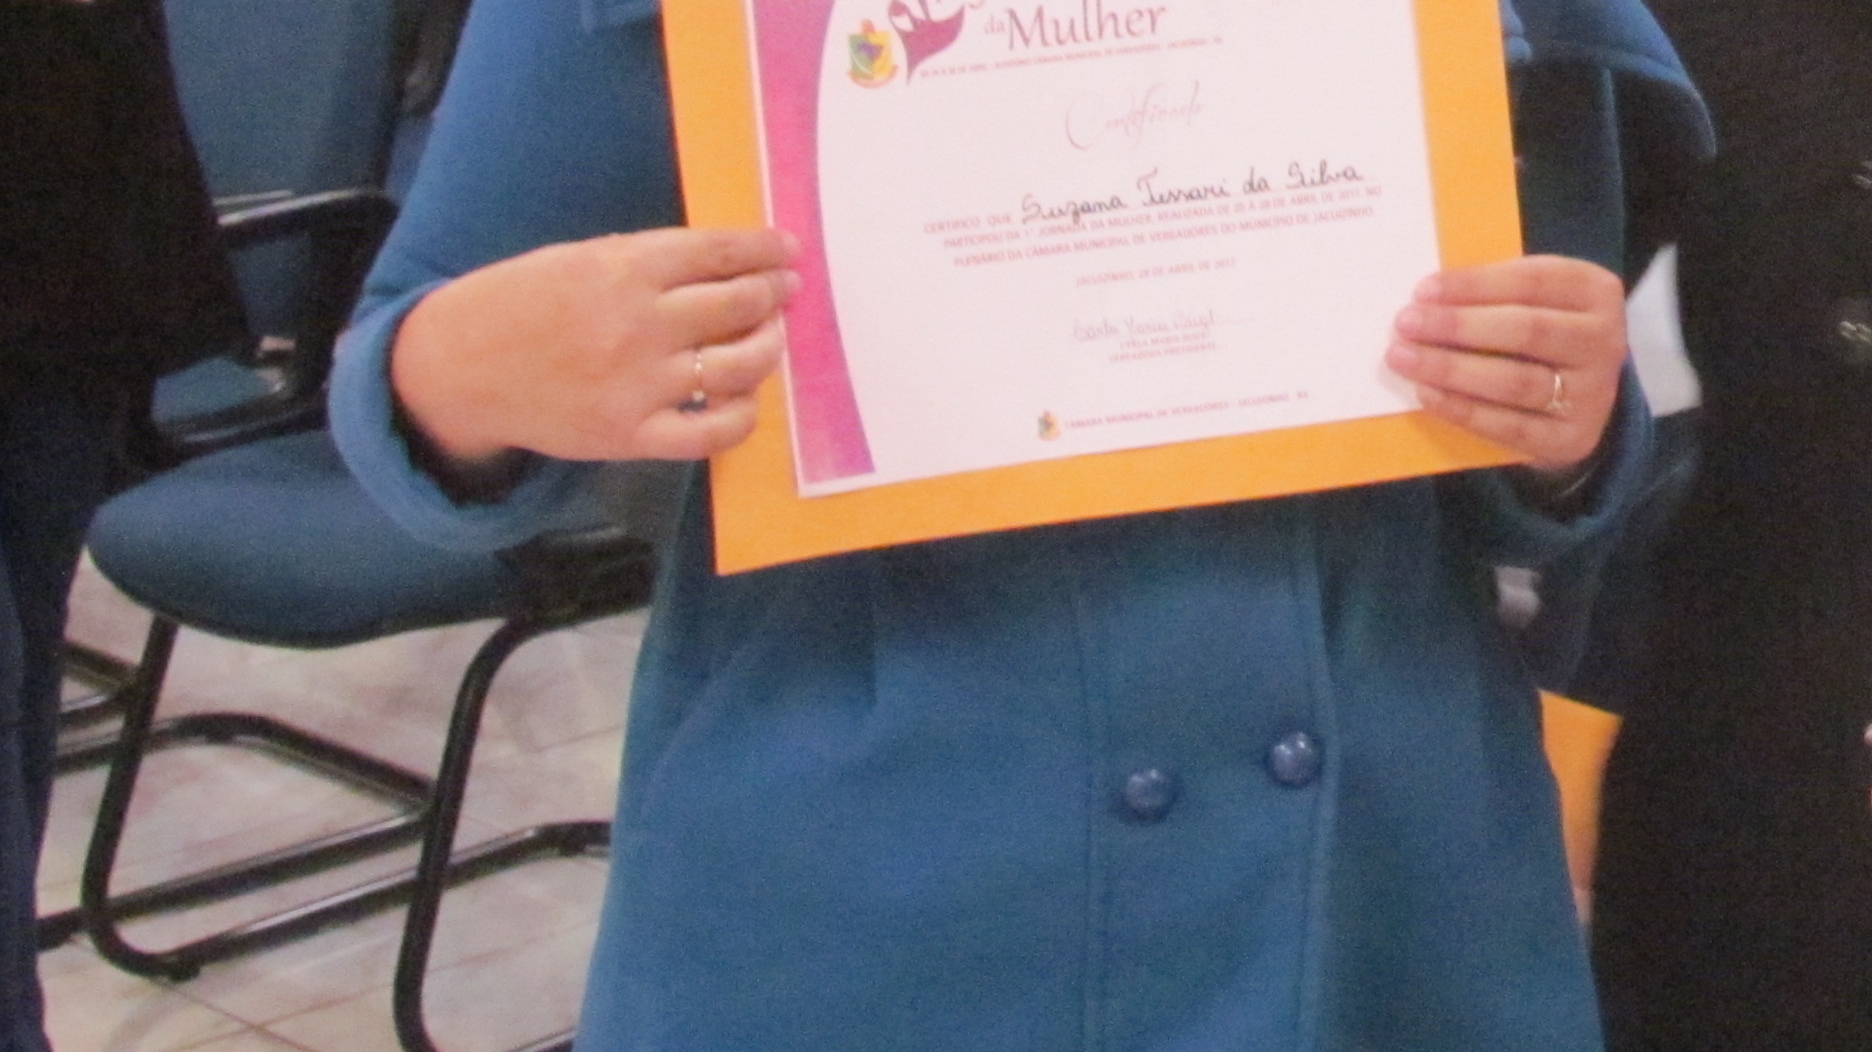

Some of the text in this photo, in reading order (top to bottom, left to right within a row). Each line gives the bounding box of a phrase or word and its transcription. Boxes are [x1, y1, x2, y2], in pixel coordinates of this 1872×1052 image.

[985, 15, 1005, 35] da
[1242, 166, 1271, 195] da
[1285, 159, 1364, 190] Silva
[924, 212, 1012, 234] CERTIFICO QUE
[943, 231, 1004, 249] PARTICIPOU
[1038, 222, 1087, 238] JORNADA
[1090, 220, 1105, 232] DA
[1007, 248, 1023, 261] DA
[1025, 241, 1072, 259] CÂMARA
[1073, 235, 1130, 252] MUNICIPAL
[1132, 233, 1146, 245] DE
[1150, 221, 1218, 243] VEREADORES
